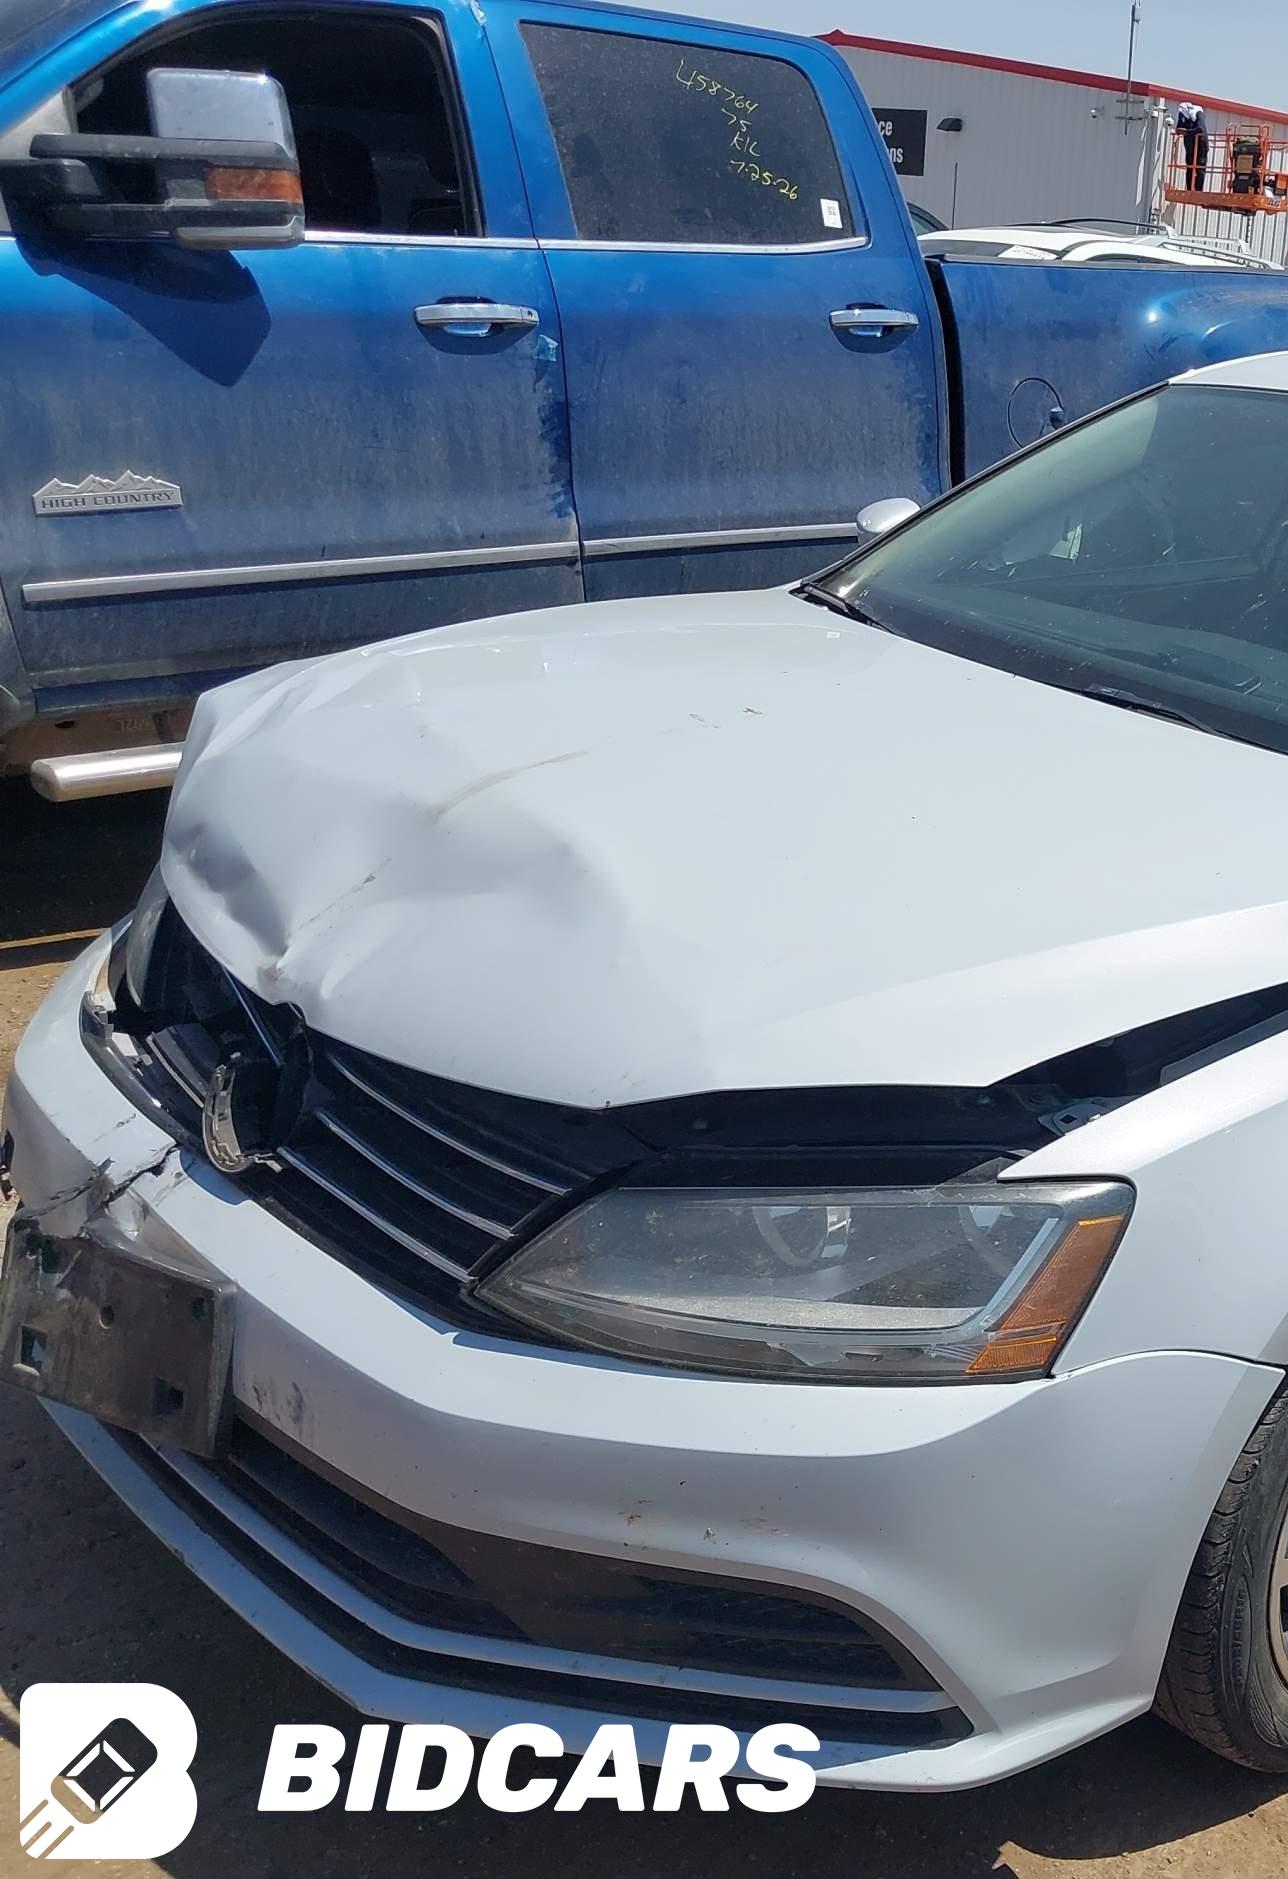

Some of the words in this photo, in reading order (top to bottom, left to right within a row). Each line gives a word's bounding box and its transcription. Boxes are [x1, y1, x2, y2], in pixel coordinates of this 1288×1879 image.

[676, 59, 759, 113] 458764
[41, 497, 86, 509] HIGH
[93, 491, 174, 506] COUNTRY
